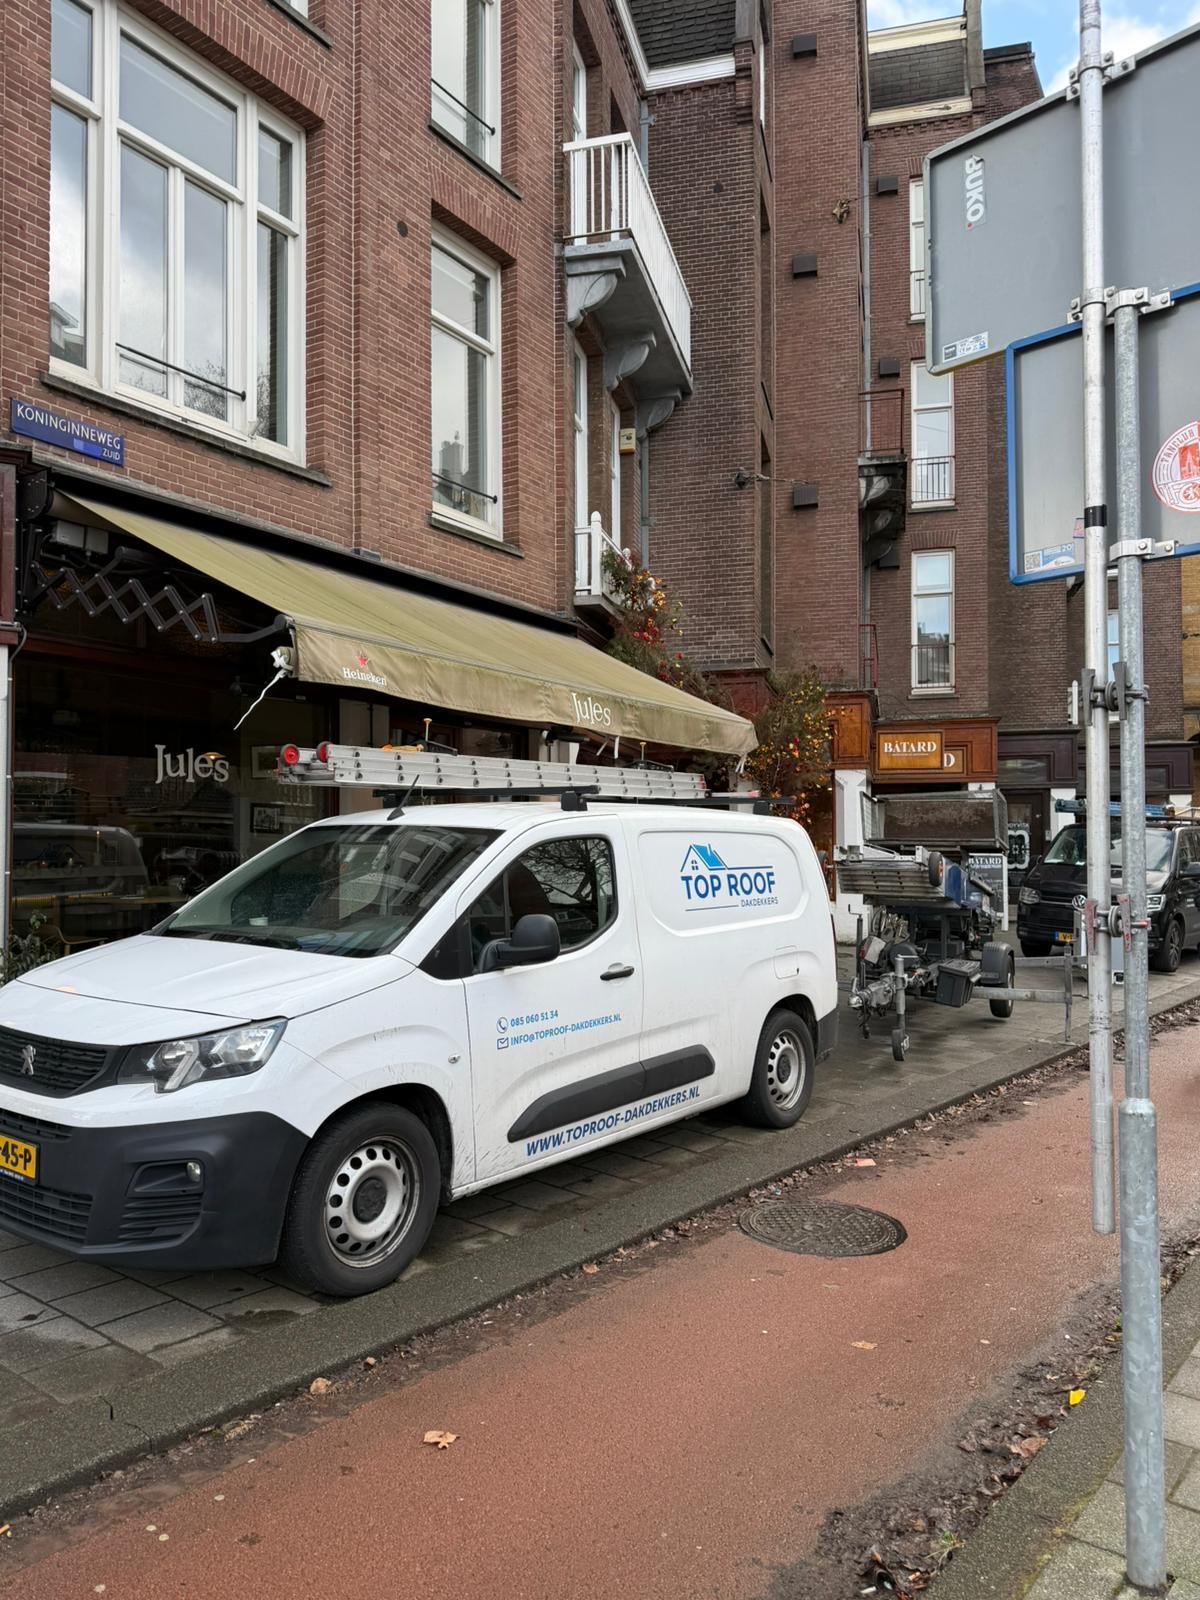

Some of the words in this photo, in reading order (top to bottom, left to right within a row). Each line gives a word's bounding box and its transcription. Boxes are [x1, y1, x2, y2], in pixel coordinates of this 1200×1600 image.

[16, 404, 121, 450] KONINGINNEWEG
[102, 447, 121, 461] ZUID
[342, 667, 387, 686] Heineken
[571, 692, 611, 726] Jules
[154, 743, 230, 785] Jules
[681, 874, 722, 900] TOP
[726, 871, 776, 897] ROOF
[740, 896, 780, 908] DAKDEKKERS
[510, 1016, 525, 1028] 085
[525, 1013, 540, 1023] 060
[540, 1012, 549, 1021] 51
[549, 1009, 559, 1019] 34
[510, 1014, 622, 1046] INFO@TOPROOF-DAKDEKKERS.NL
[526, 1085, 701, 1157] WWW.TOPROOF-DAKDEKKERS.NL
